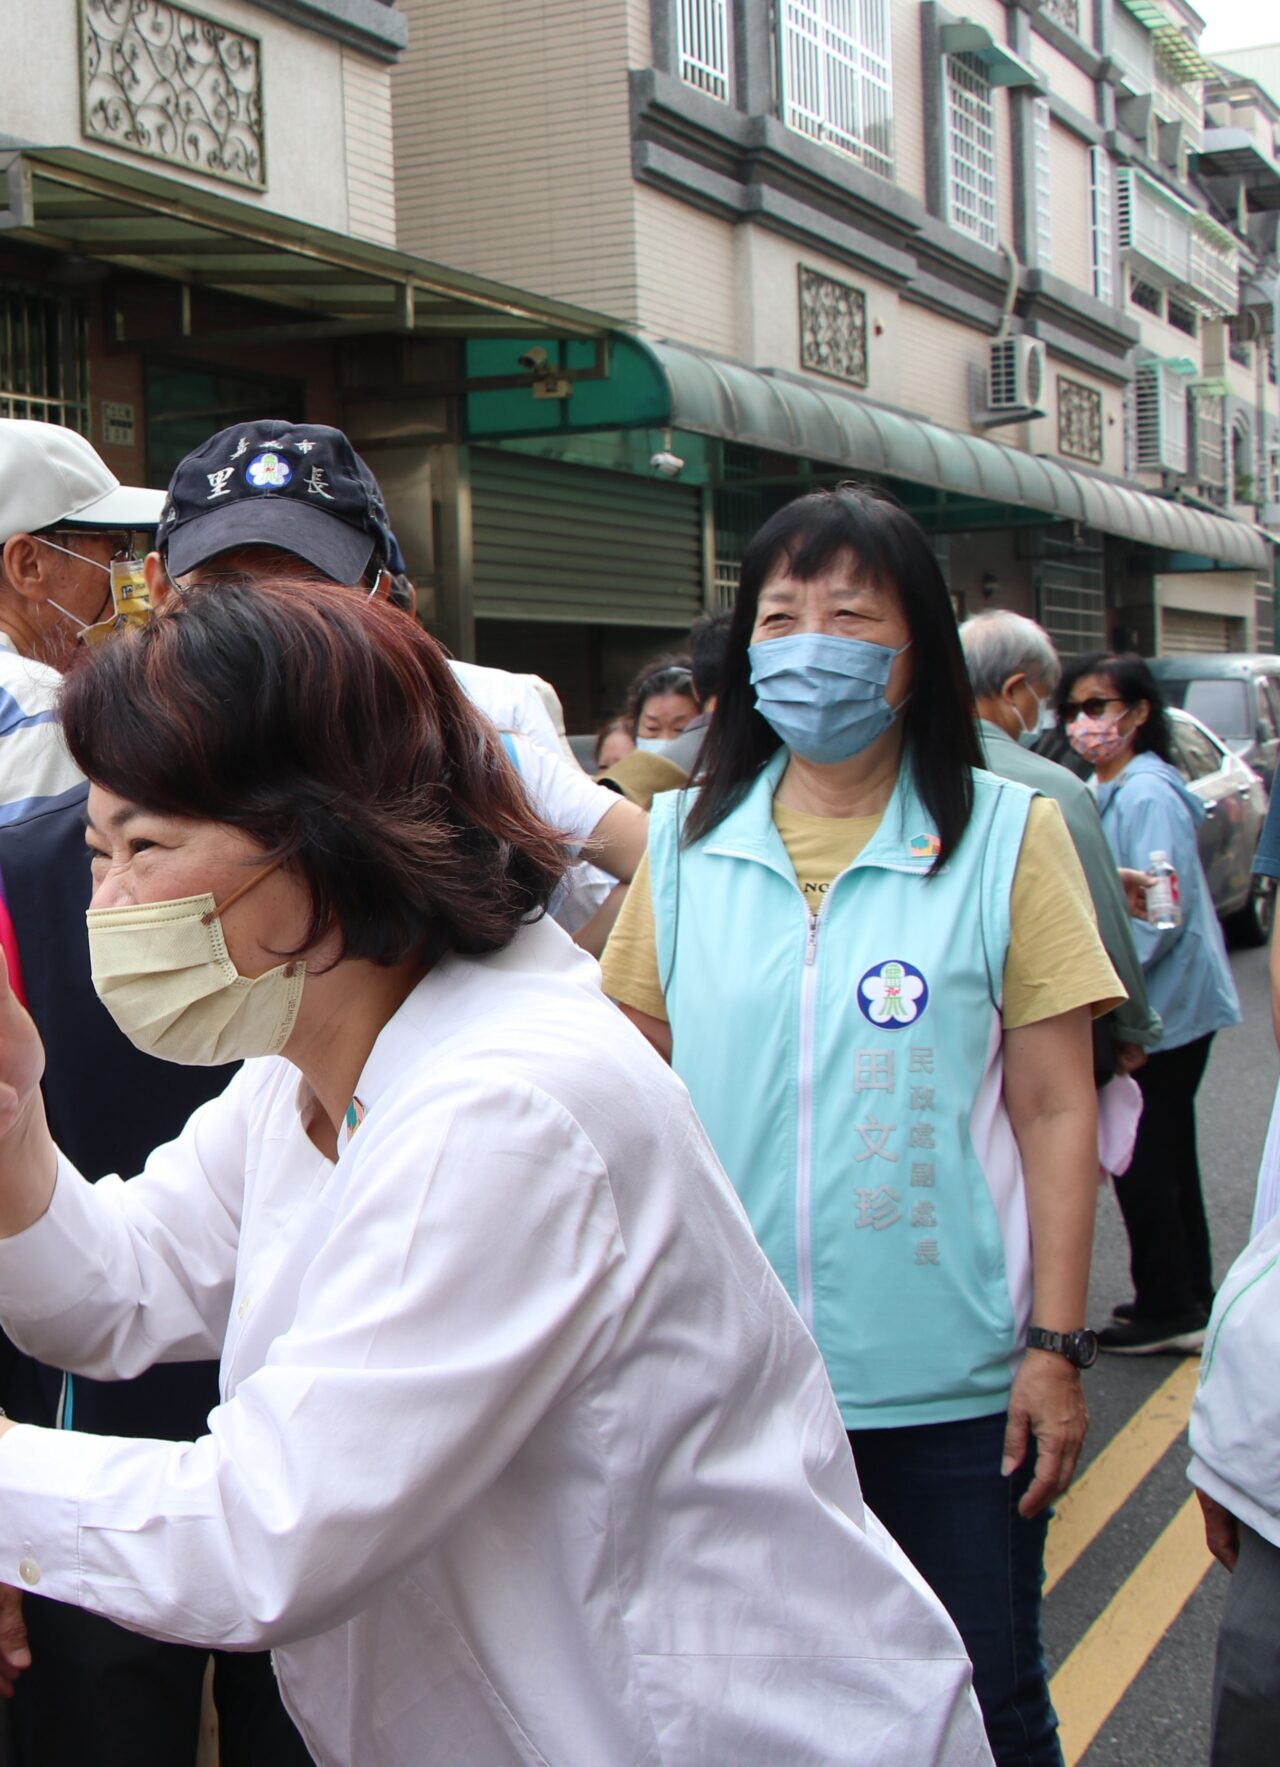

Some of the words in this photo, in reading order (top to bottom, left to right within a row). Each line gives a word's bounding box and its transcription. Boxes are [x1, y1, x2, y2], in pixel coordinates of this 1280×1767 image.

[281, 998, 297, 1027] Taiwan
[853, 1048, 903, 1232] 田文珍
[907, 1046, 941, 1266] 民政處副處長
